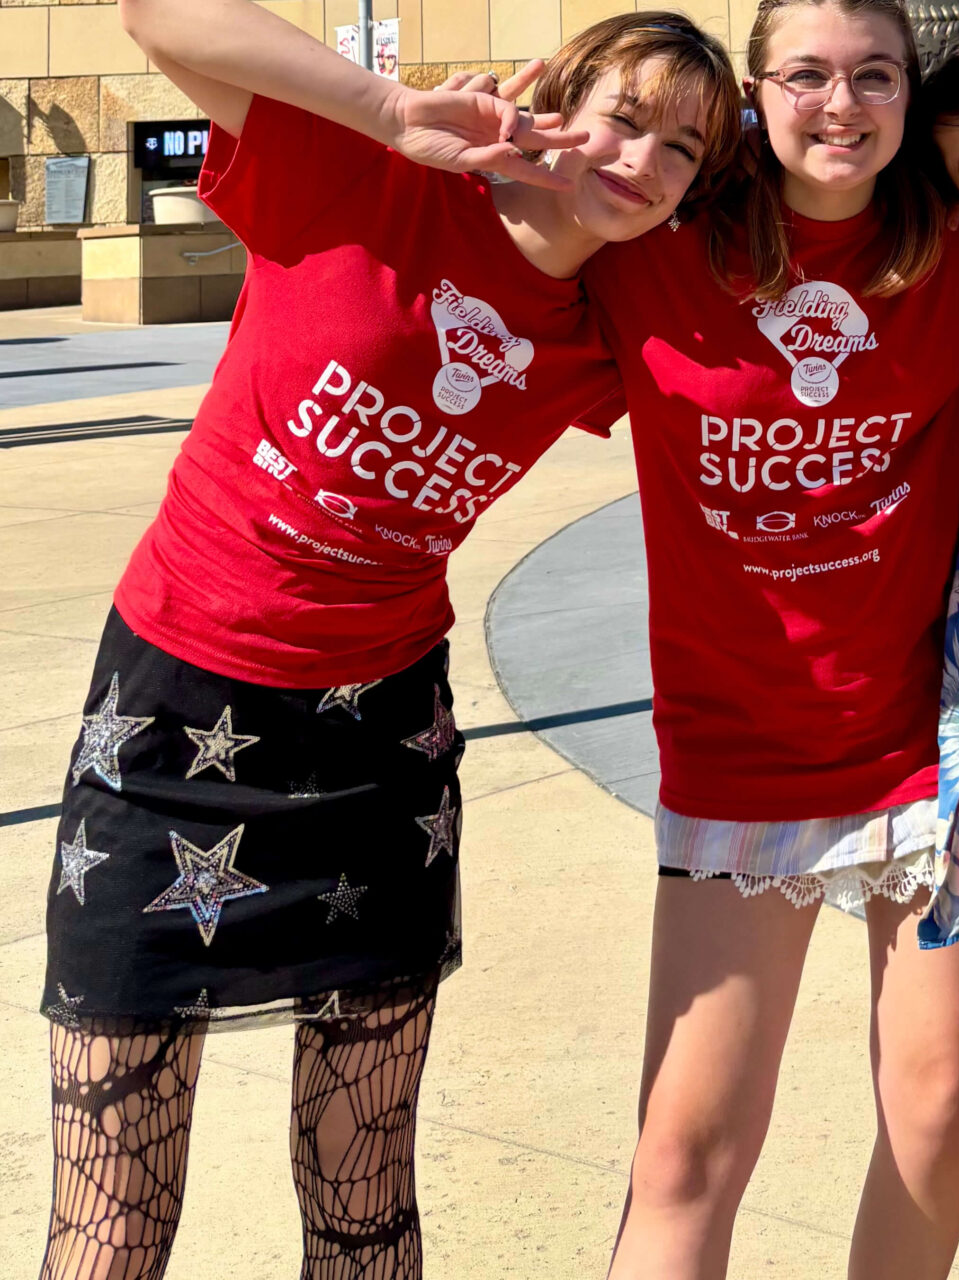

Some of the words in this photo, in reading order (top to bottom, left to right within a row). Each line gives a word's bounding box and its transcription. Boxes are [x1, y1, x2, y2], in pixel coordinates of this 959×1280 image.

[164, 131, 184, 156] NO
[752, 290, 850, 331] Fielding
[787, 324, 879, 352] Dreams
[446, 328, 527, 390] Dreams
[803, 363, 827, 376] Twins
[451, 368, 475, 384] Twins
[437, 391, 465, 410] SUCCESS
[440, 386, 468, 403] PROJECT
[312, 360, 521, 493] PROJECT
[701, 412, 912, 451] PROJECT
[256, 438, 298, 474] BEST
[287, 399, 488, 523] SUCCESS
[870, 481, 911, 516] Twins
[425, 535, 453, 555] Twins
[743, 534, 791, 543] BRIDGEWATER
[743, 548, 880, 582] www.projectsuccess.org
